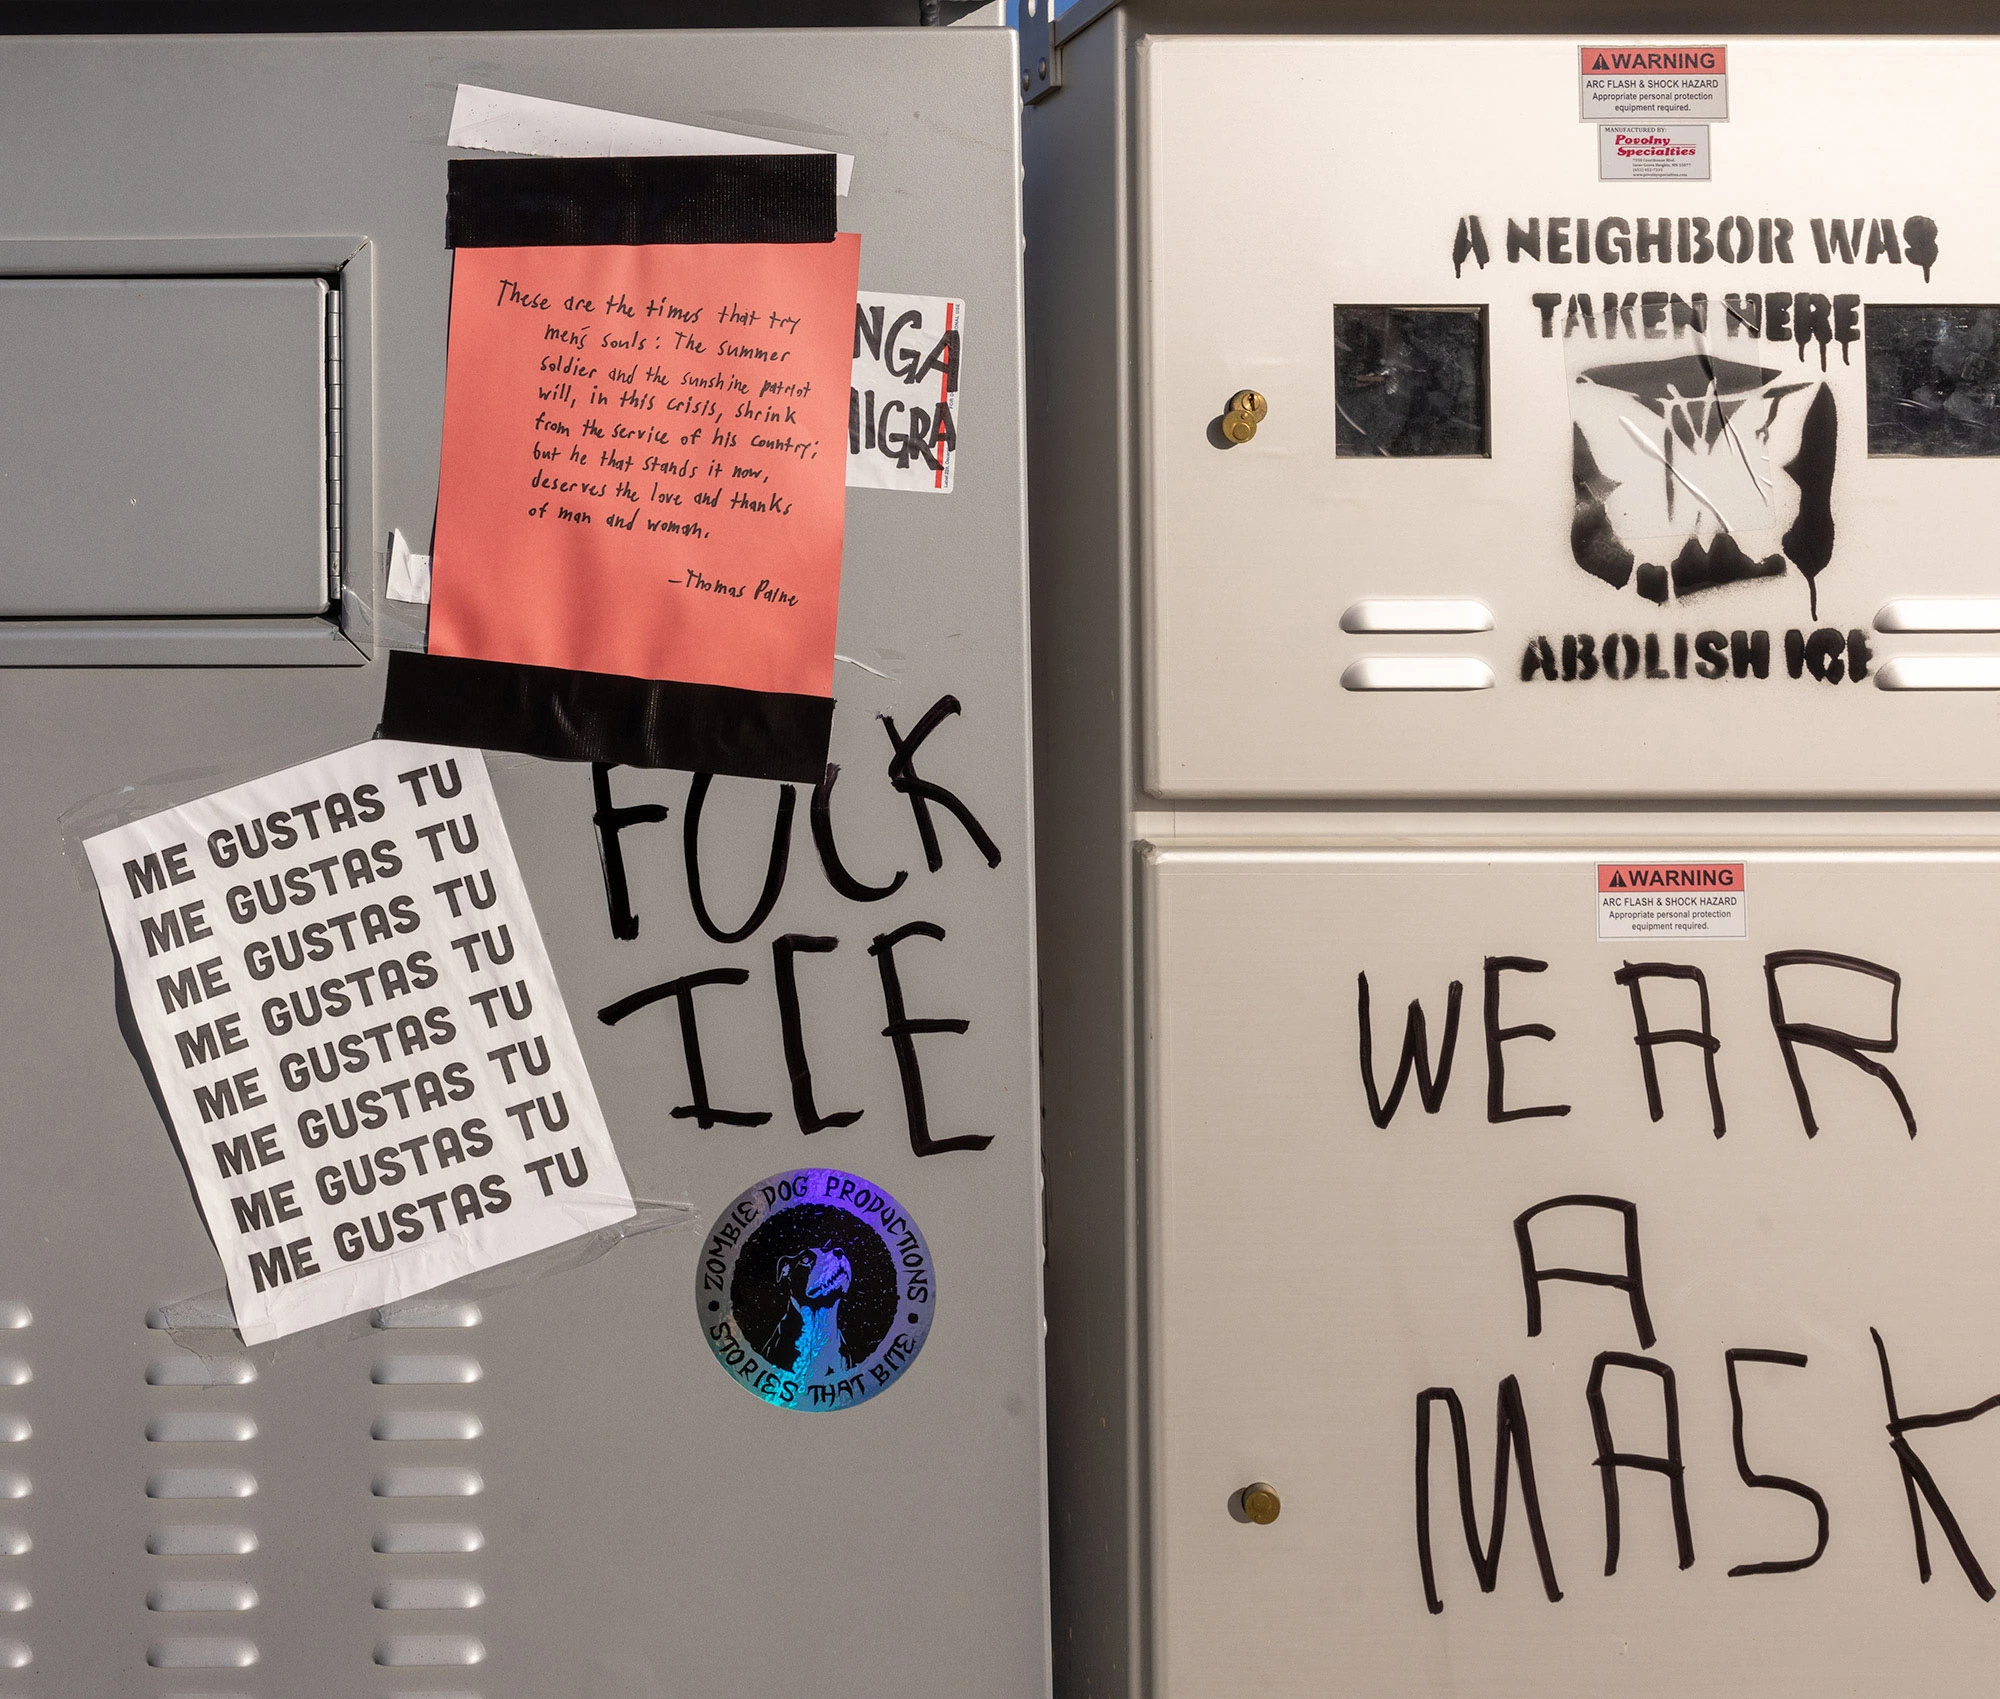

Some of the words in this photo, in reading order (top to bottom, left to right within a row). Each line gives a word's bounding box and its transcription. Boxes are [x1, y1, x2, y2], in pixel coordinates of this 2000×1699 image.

[1586, 80, 1605, 88] ARC
[1607, 80, 1636, 88] FLASH
[1639, 80, 1645, 88] &
[1648, 80, 1679, 88] SHOCK
[1682, 79, 1718, 87] HAZARD
[1611, 53, 1715, 69] WARNING
[1592, 92, 1637, 101] Appropriate
[1640, 92, 1672, 101] personal
[1675, 92, 1713, 101] protection
[1615, 104, 1655, 112] equipment
[1657, 104, 1691, 112] required.
[1615, 135, 1670, 146] Povolny
[1617, 147, 1696, 157] Specialties
[1452, 215, 1490, 274] A
[1505, 216, 1794, 265] NEIGHBOR
[1810, 216, 1938, 276] WAS
[497, 279, 551, 310] These
[563, 296, 595, 312] are
[606, 295, 635, 318] the
[646, 297, 703, 323] times
[717, 303, 761, 326] that
[769, 311, 800, 334] try
[1531, 291, 1708, 340] TAKEN
[1724, 291, 1861, 359] HERE
[544, 324, 591, 349] men's
[675, 331, 706, 353] The
[717, 340, 791, 362] summer
[538, 383, 576, 408] will,
[590, 385, 608, 405] in
[620, 389, 654, 410] this
[667, 397, 723, 423] crisis,
[735, 400, 797, 424] shrink
[540, 355, 598, 378] soldier
[609, 365, 638, 384] and
[646, 366, 669, 386] the
[681, 371, 749, 394] sunshine
[759, 381, 811, 399] patriot
[536, 412, 570, 437] from
[583, 419, 605, 438] the
[612, 423, 669, 444] service
[680, 428, 701, 445] of
[712, 428, 736, 446] his
[533, 441, 561, 461] but
[570, 444, 587, 465] he
[600, 449, 634, 472] that
[643, 456, 698, 478] stands
[708, 460, 723, 477] it
[732, 465, 768, 483] now,
[529, 502, 548, 518] of
[558, 507, 591, 524] man
[606, 508, 640, 530] and
[532, 469, 606, 497] deserves
[616, 481, 639, 502] the
[651, 482, 683, 506] love
[694, 488, 722, 508] and
[731, 492, 792, 515] thanks
[754, 579, 799, 607] Paine
[1520, 629, 1770, 682] ABOLISH
[1784, 627, 1874, 685] ICE
[123, 843, 196, 899] ME
[208, 784, 385, 868] GUSTAS
[398, 759, 462, 807] TU
[591, 694, 1002, 944] FUCK
[140, 900, 213, 957] ME
[226, 840, 402, 924] GUSTAS
[415, 814, 478, 862] TU
[1603, 898, 1621, 906] ARC
[1625, 898, 1653, 906] FLASH
[1666, 897, 1697, 905] SHOCK
[1700, 897, 1737, 905] HAZARD
[1629, 870, 1733, 886] WARNING
[157, 956, 231, 1014] ME
[244, 896, 420, 980] GUSTAS
[433, 869, 496, 917] TU
[1609, 911, 1654, 920] Appropriate
[1657, 911, 1690, 919] personal
[1693, 910, 1731, 919] protection
[1632, 922, 1672, 930] equipment
[1675, 922, 1709, 930] required.
[175, 1013, 249, 1069] ME
[262, 951, 438, 1035] GUSTAS
[451, 925, 514, 972] TU
[193, 1068, 267, 1123] ME
[280, 1007, 456, 1092] GUSTAS
[469, 980, 532, 1028] TU
[597, 921, 995, 1157] ICE
[1357, 949, 1917, 1140] WEAR
[212, 1124, 285, 1178] ME
[298, 1063, 474, 1148] GUSTAS
[487, 1036, 550, 1084] TU
[231, 1180, 303, 1233] ME
[316, 1119, 493, 1205] GUSTAS
[505, 1091, 569, 1140] TU
[248, 1237, 320, 1293] ME
[334, 1175, 511, 1261] GUSTAS
[524, 1147, 588, 1196] TU
[704, 1201, 759, 1291] ZOMBIE
[759, 1176, 809, 1209] DOG
[824, 1176, 928, 1303] PRODUCTIONS
[1512, 1194, 1657, 1350] A
[710, 1321, 798, 1402] STORIES
[808, 1373, 866, 1407] THAT
[870, 1333, 918, 1386] BITE
[1415, 1326, 2000, 1615] MASK
